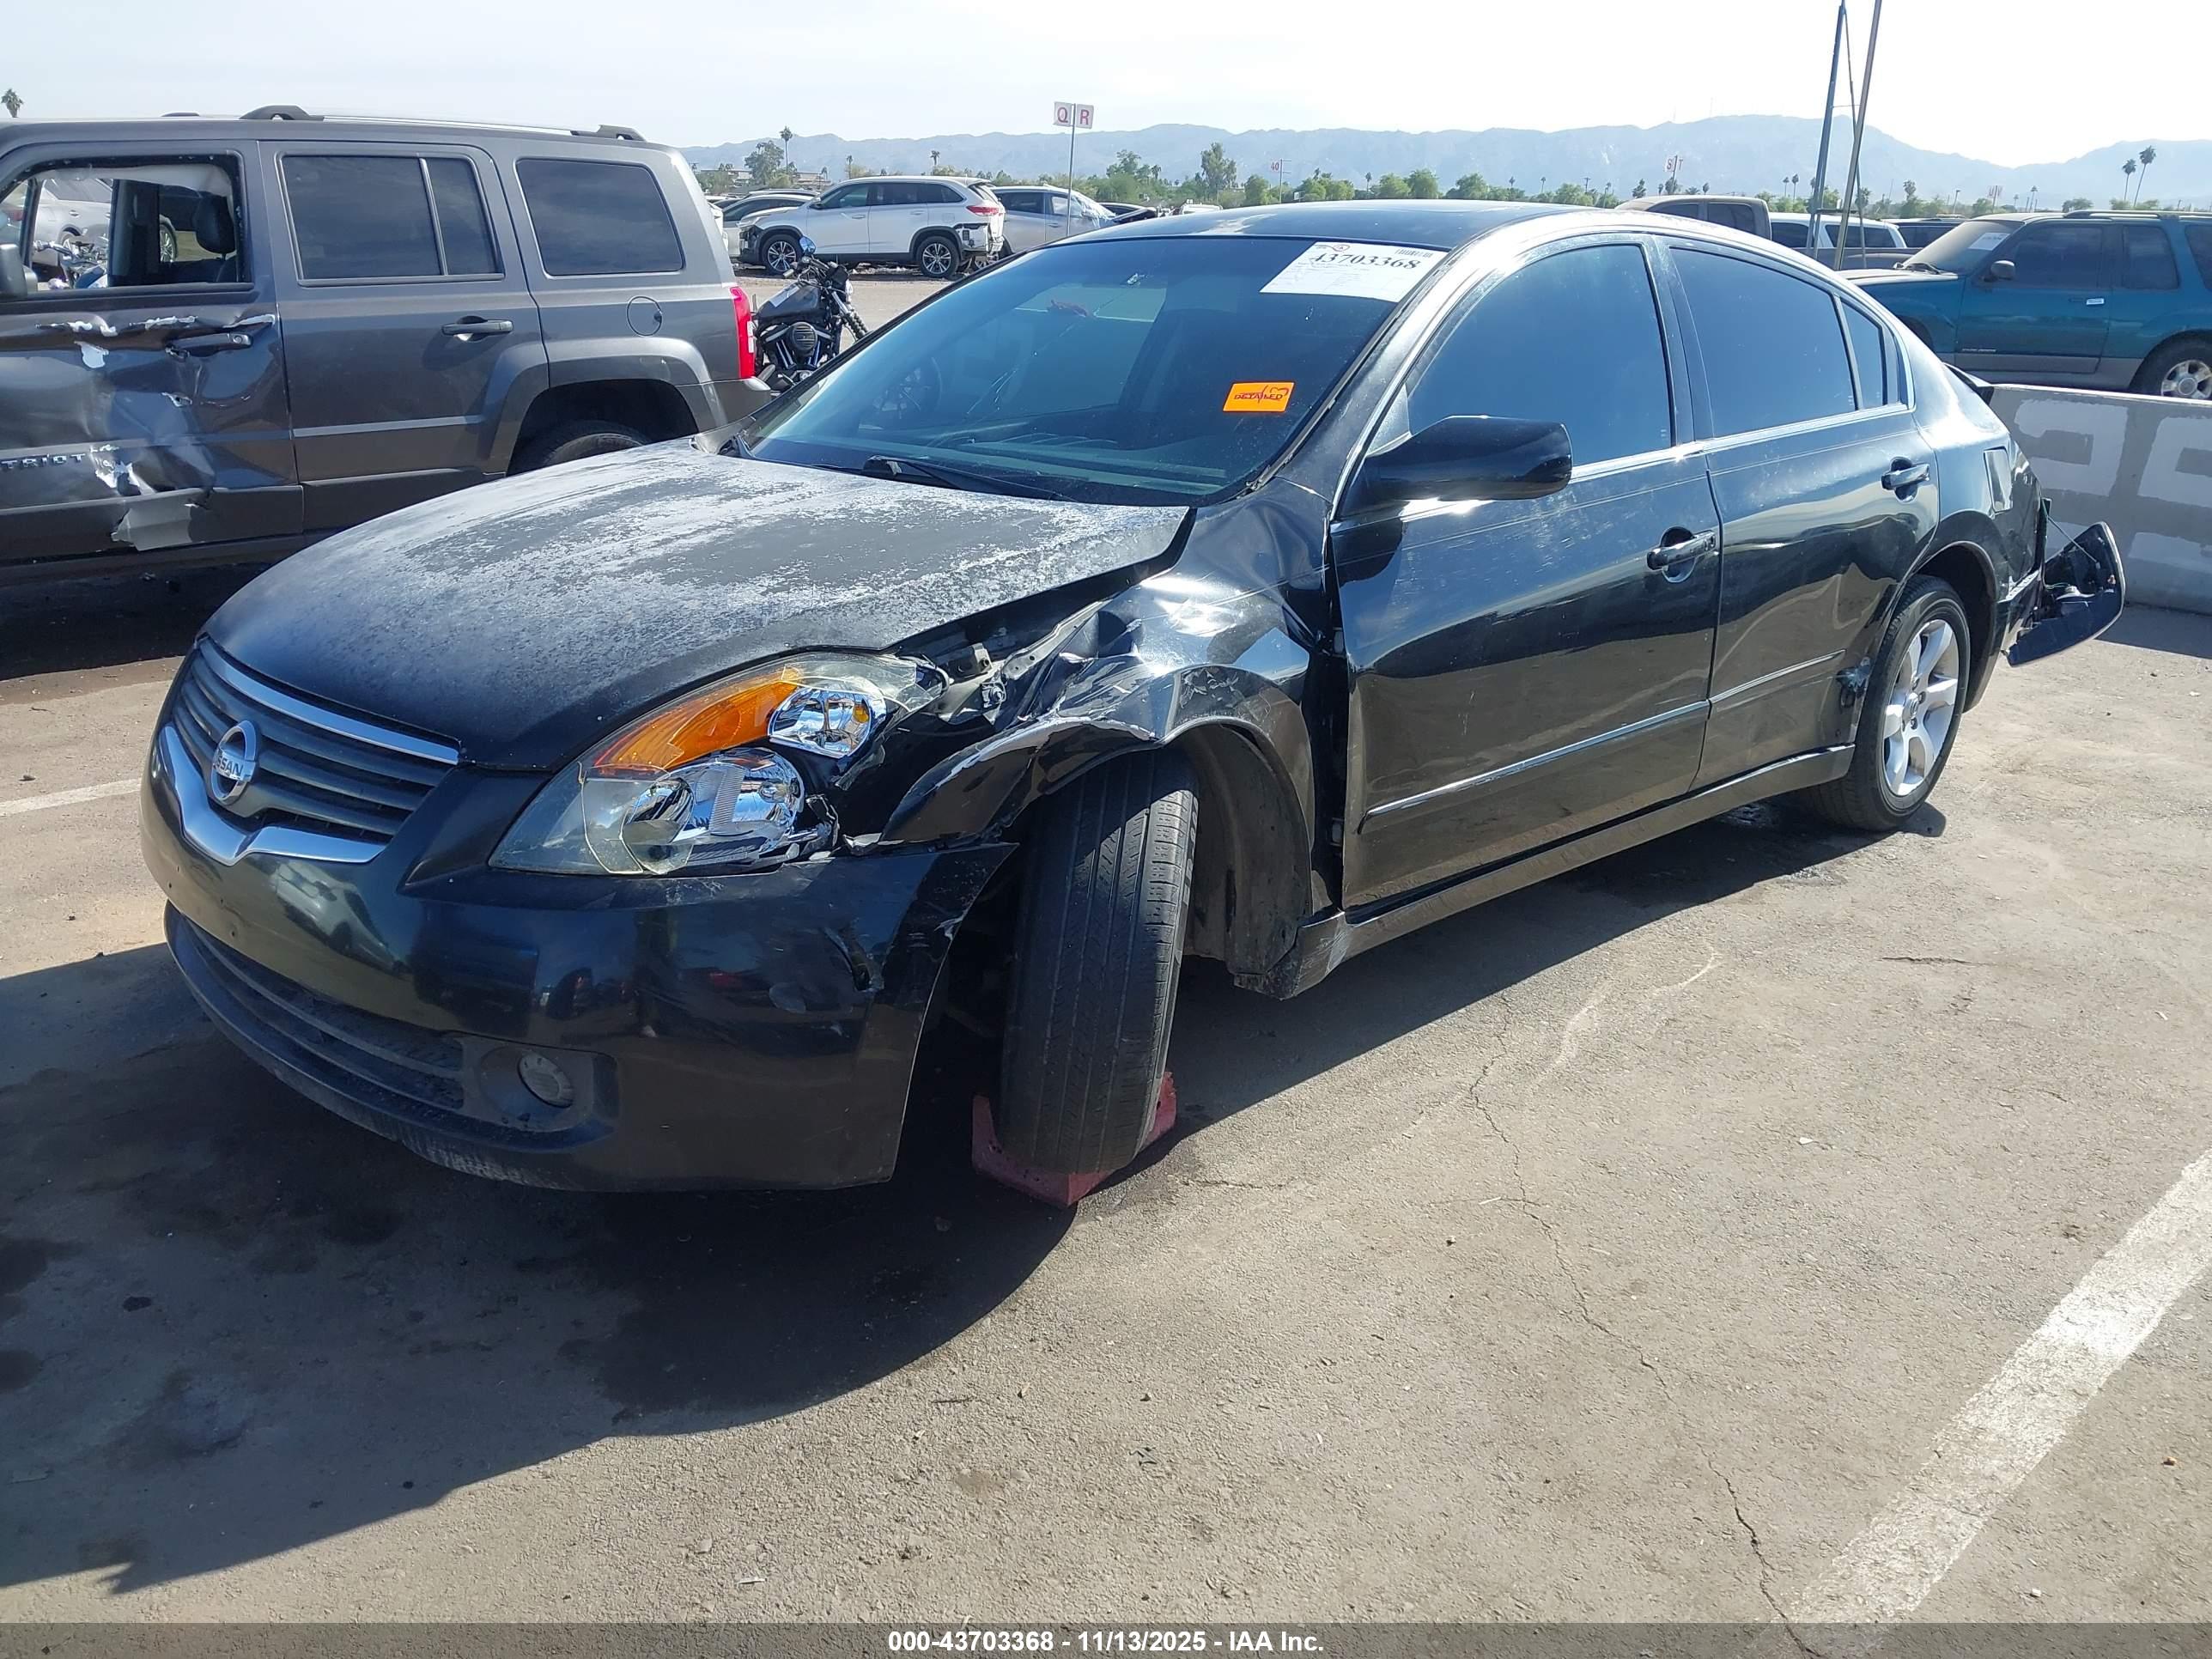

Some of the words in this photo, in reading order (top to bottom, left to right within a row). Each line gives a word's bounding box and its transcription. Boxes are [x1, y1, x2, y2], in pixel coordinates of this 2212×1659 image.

[1057, 106, 1069, 124] Q
[1079, 109, 1090, 125] R
[1271, 161, 1279, 171] 40
[1667, 158, 1673, 170] S
[1310, 252, 1421, 270] 43703368
[213, 753, 244, 777] SSAN
